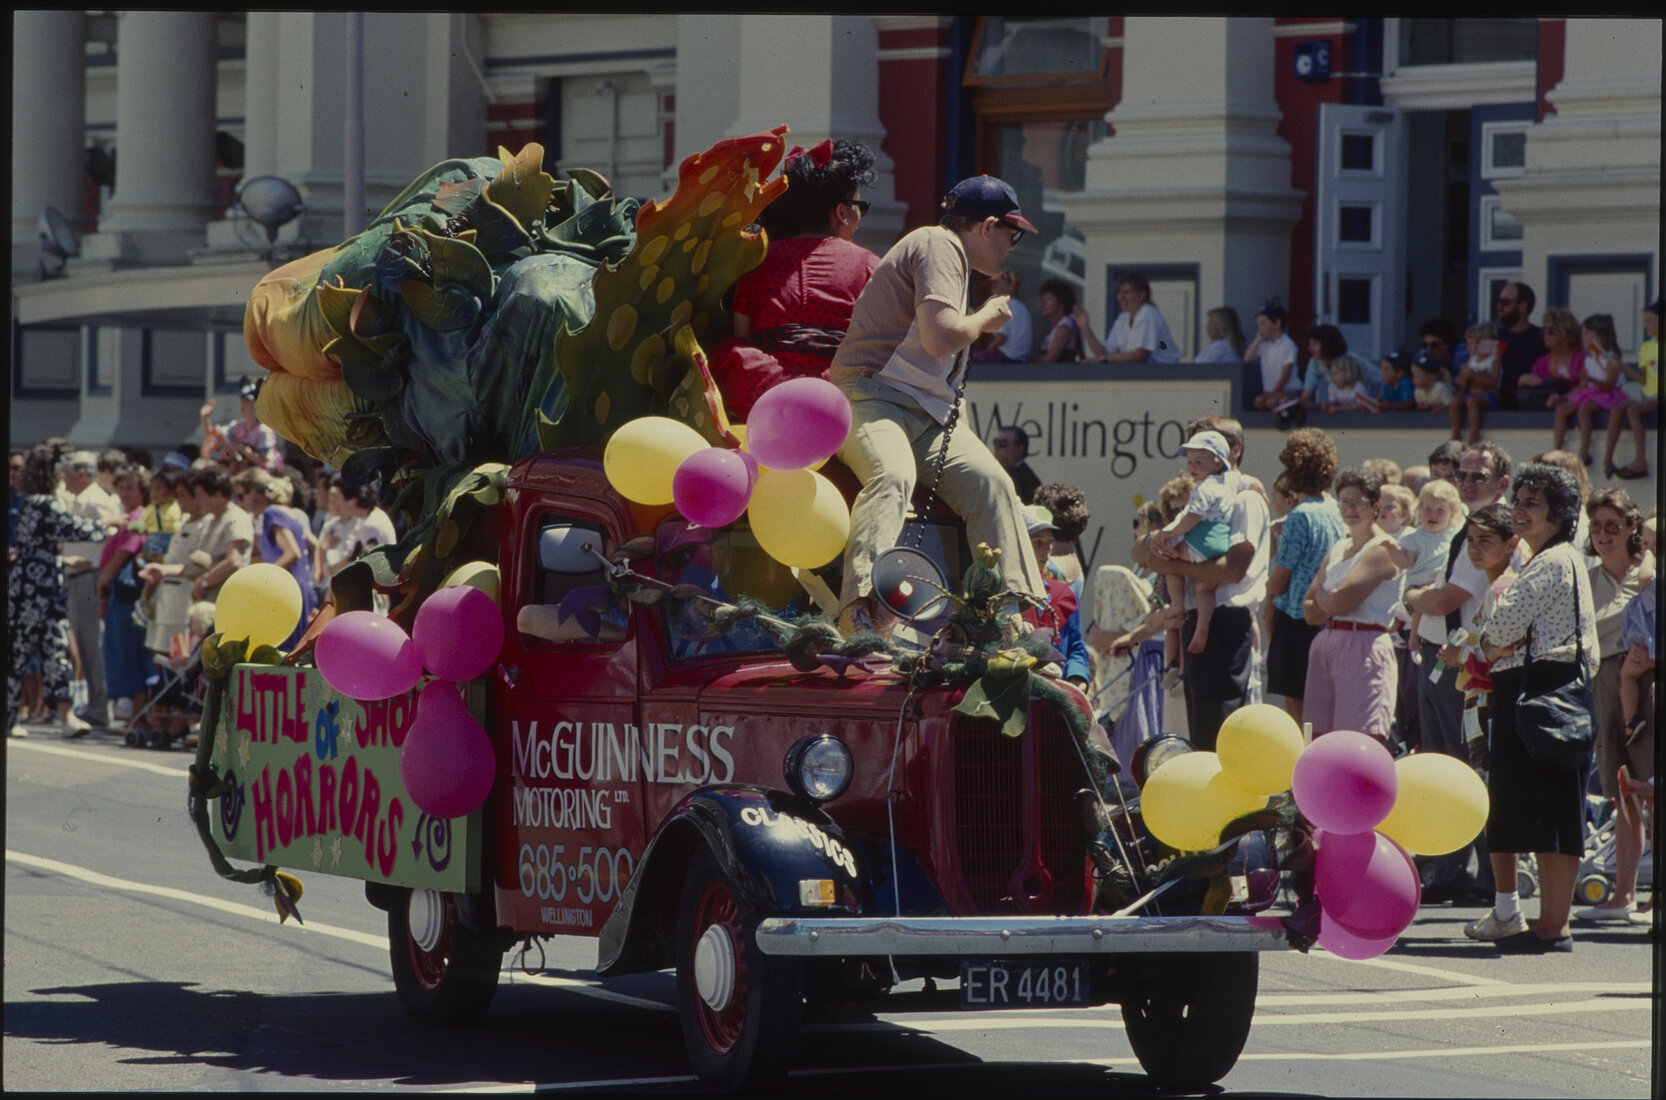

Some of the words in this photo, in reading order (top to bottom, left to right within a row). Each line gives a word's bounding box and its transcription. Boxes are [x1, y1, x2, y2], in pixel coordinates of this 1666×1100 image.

[970, 402, 1192, 479] Wellingto
[236, 669, 309, 745] LITTLE
[355, 690, 421, 749] SHO
[315, 699, 339, 761] OF
[511, 720, 736, 785] McGUINNESS
[251, 752, 404, 878] HORRORS
[513, 786, 612, 831] MOTORING
[541, 906, 594, 927] WELLINGTON
[967, 967, 1009, 1002] ER
[1017, 966, 1082, 1002] 4481
